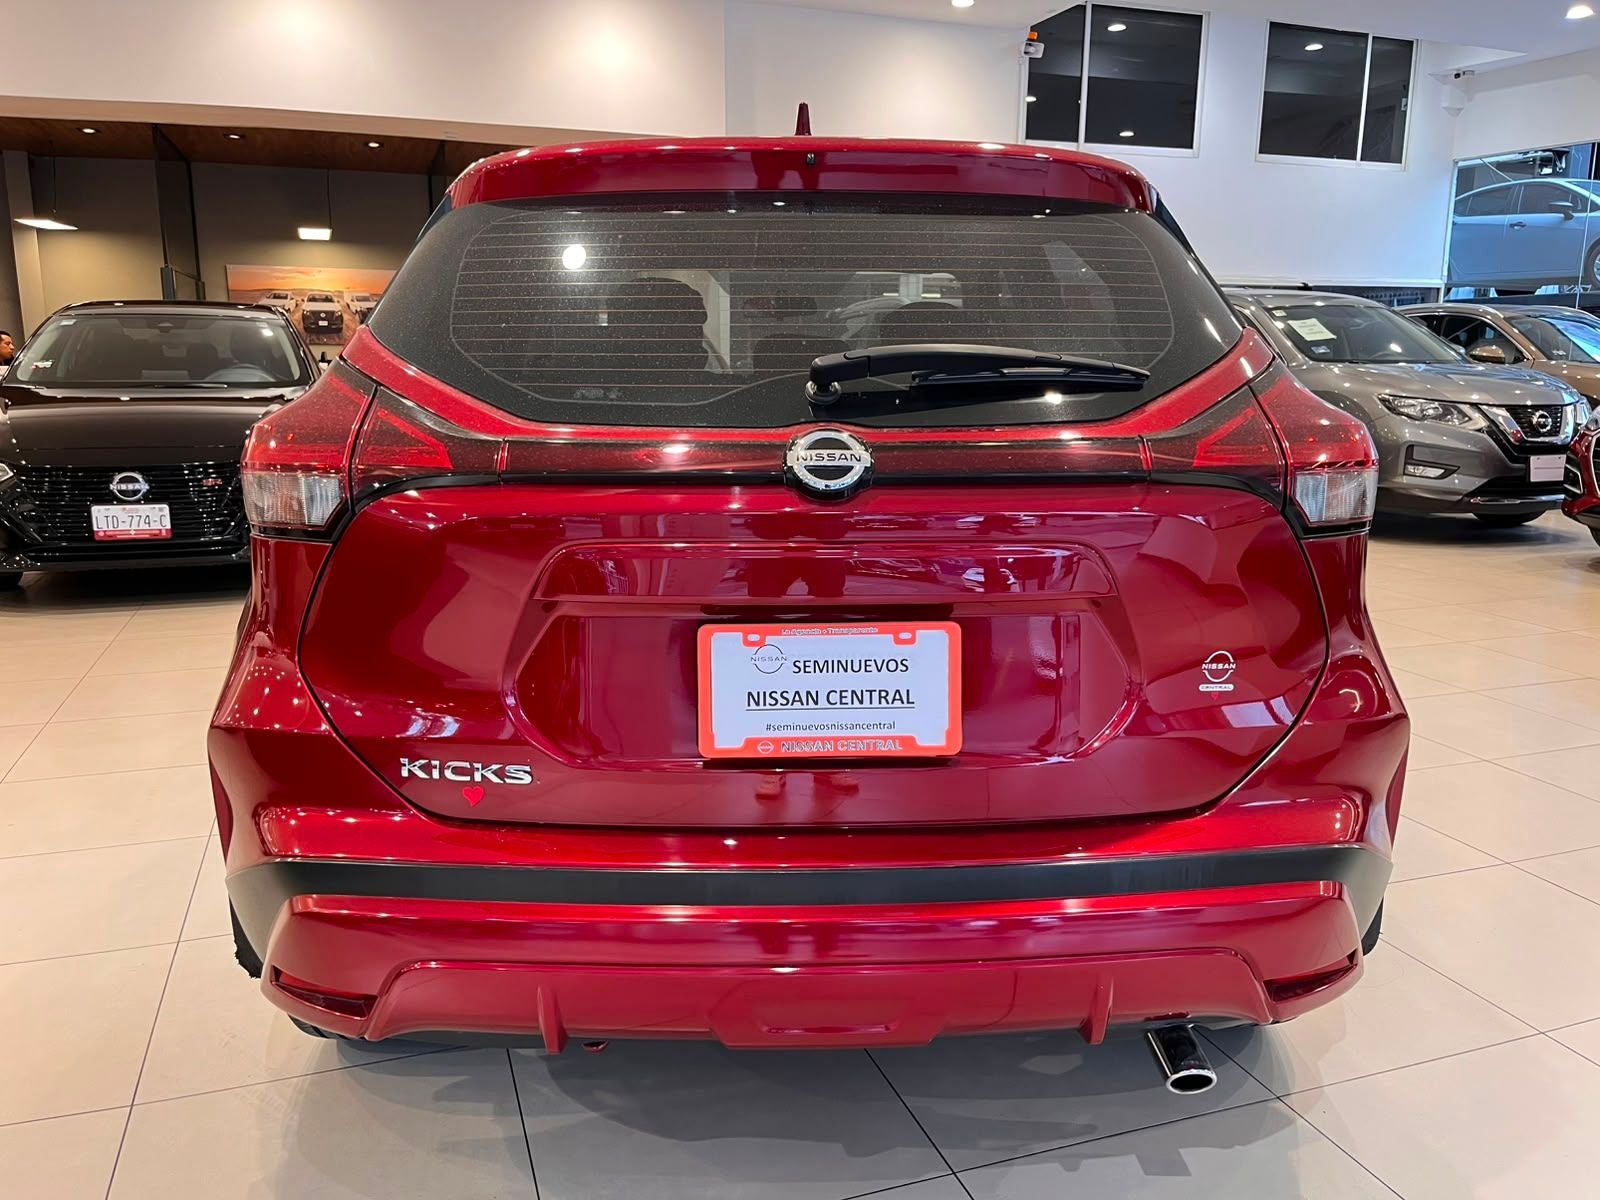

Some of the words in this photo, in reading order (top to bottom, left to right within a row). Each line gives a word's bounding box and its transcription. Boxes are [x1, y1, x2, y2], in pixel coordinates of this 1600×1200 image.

[796, 452, 861, 463] NISSAN
[95, 513, 167, 530] LTD-774-C
[792, 658, 909, 674] SEMINUEVOS
[746, 689, 819, 707] NISSAN
[826, 688, 916, 706] CENTRAL
[765, 720, 896, 732] #seminuevosnissancentral
[780, 740, 834, 753] NISSAN
[837, 739, 903, 752] CENTRAL
[399, 757, 533, 785] KICKS
